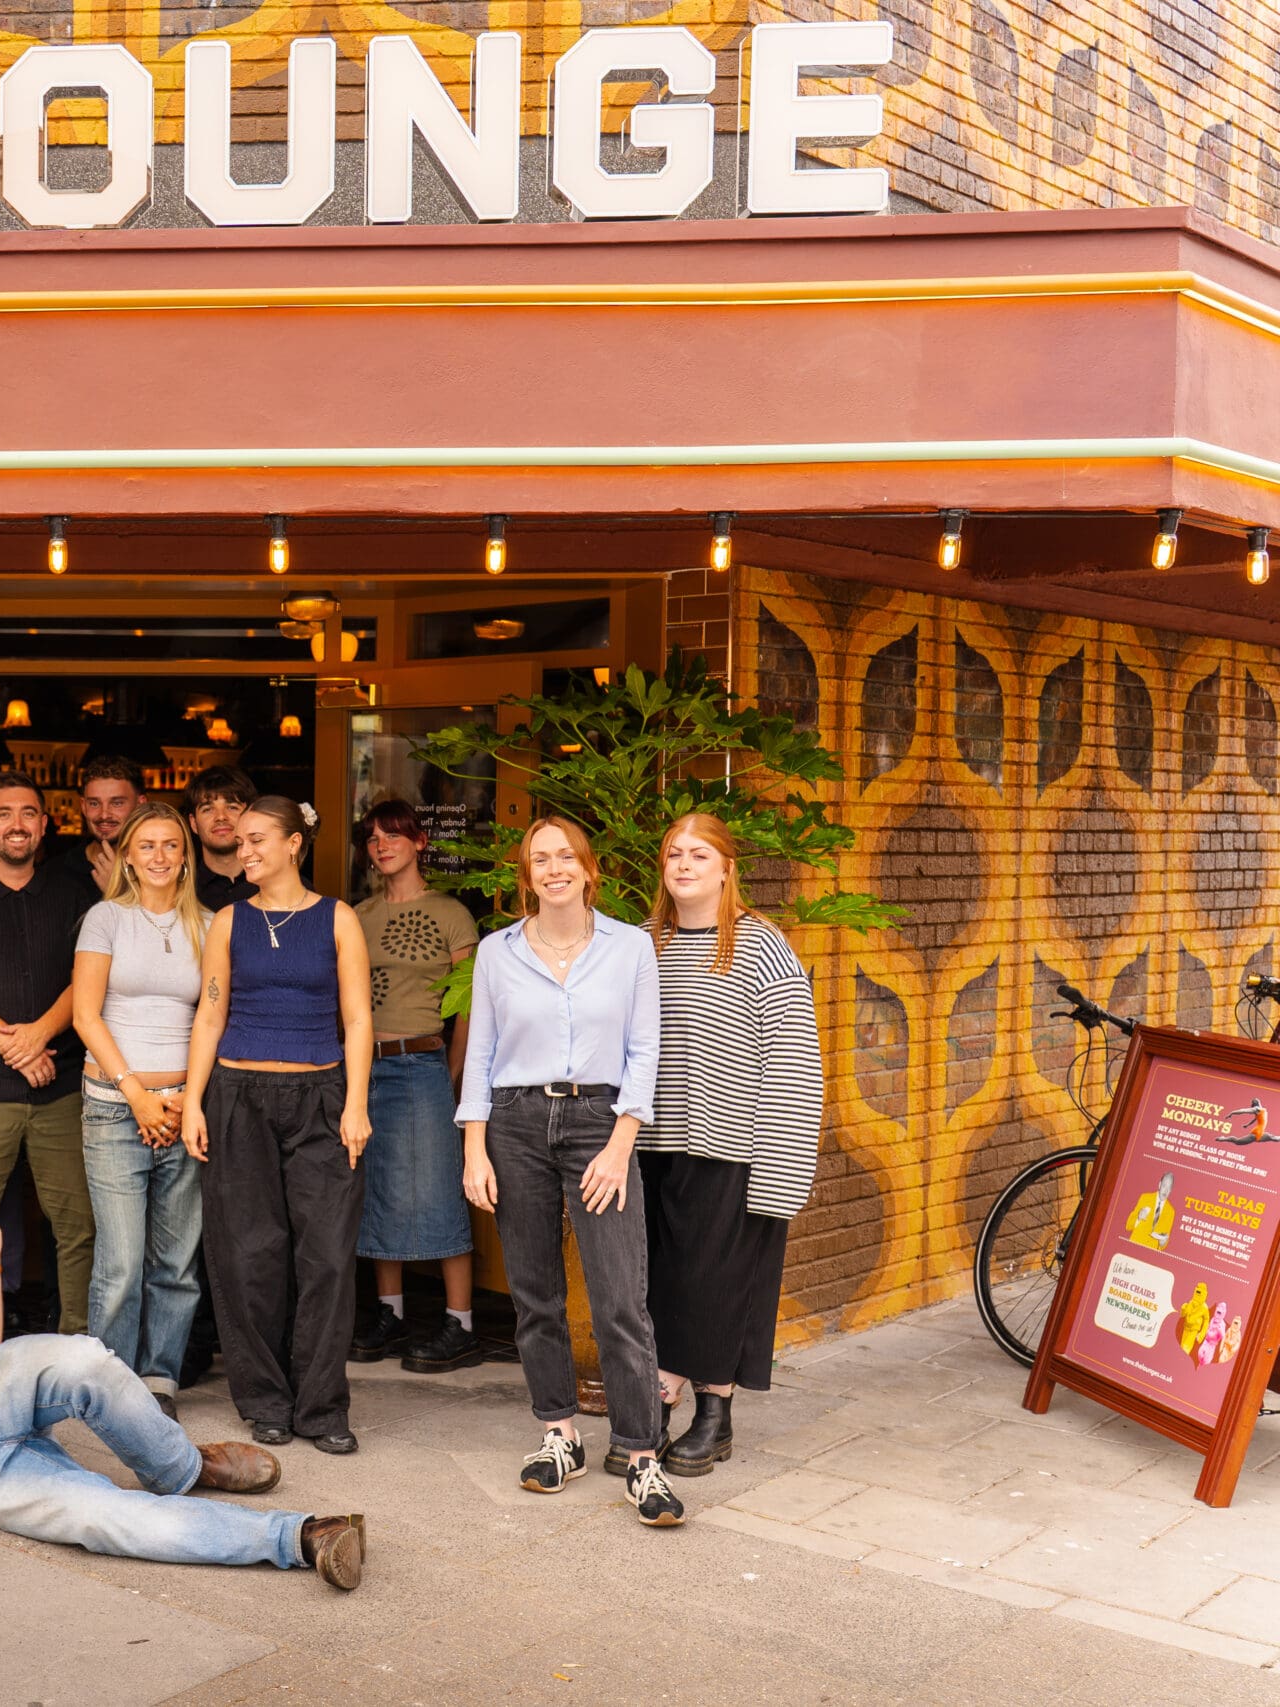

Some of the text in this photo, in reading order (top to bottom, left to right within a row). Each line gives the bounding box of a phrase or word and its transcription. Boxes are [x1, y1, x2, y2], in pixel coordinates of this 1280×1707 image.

[1166, 1094, 1224, 1117] CHEEKY
[1157, 1124, 1201, 1141] BUY ANY BURGER
[1161, 1107, 1232, 1134] MONDAYS
[1153, 1140, 1166, 1150] WINE
[1166, 1144, 1174, 1152] OR
[1206, 1155, 1218, 1164] FOR
[1235, 1163, 1252, 1173] FROM
[1155, 1132, 1163, 1140] OR
[1163, 1134, 1177, 1144] MAIN
[1182, 1139, 1194, 1148] GET
[1199, 1143, 1217, 1155] GLASS
[1217, 1148, 1226, 1157] OF
[1226, 1151, 1246, 1162] HOUSE
[1184, 1196, 1261, 1230] TUESDAYS
[1218, 1190, 1266, 1215] TAPAS
[1181, 1215, 1193, 1223] BUY
[1197, 1220, 1215, 1231] TAPAS
[1242, 1235, 1256, 1244] GET
[1184, 1226, 1203, 1236] GLASS
[1203, 1231, 1211, 1239] OF
[1190, 1236, 1202, 1245] FOR
[1218, 1244, 1235, 1256] FROM
[1108, 1286, 1159, 1312] BOARD GAMES
[1111, 1276, 1156, 1299] HIGH CHAIRS
[1105, 1297, 1151, 1321] NEWSPAPERS
[1121, 1316, 1137, 1330] Come
